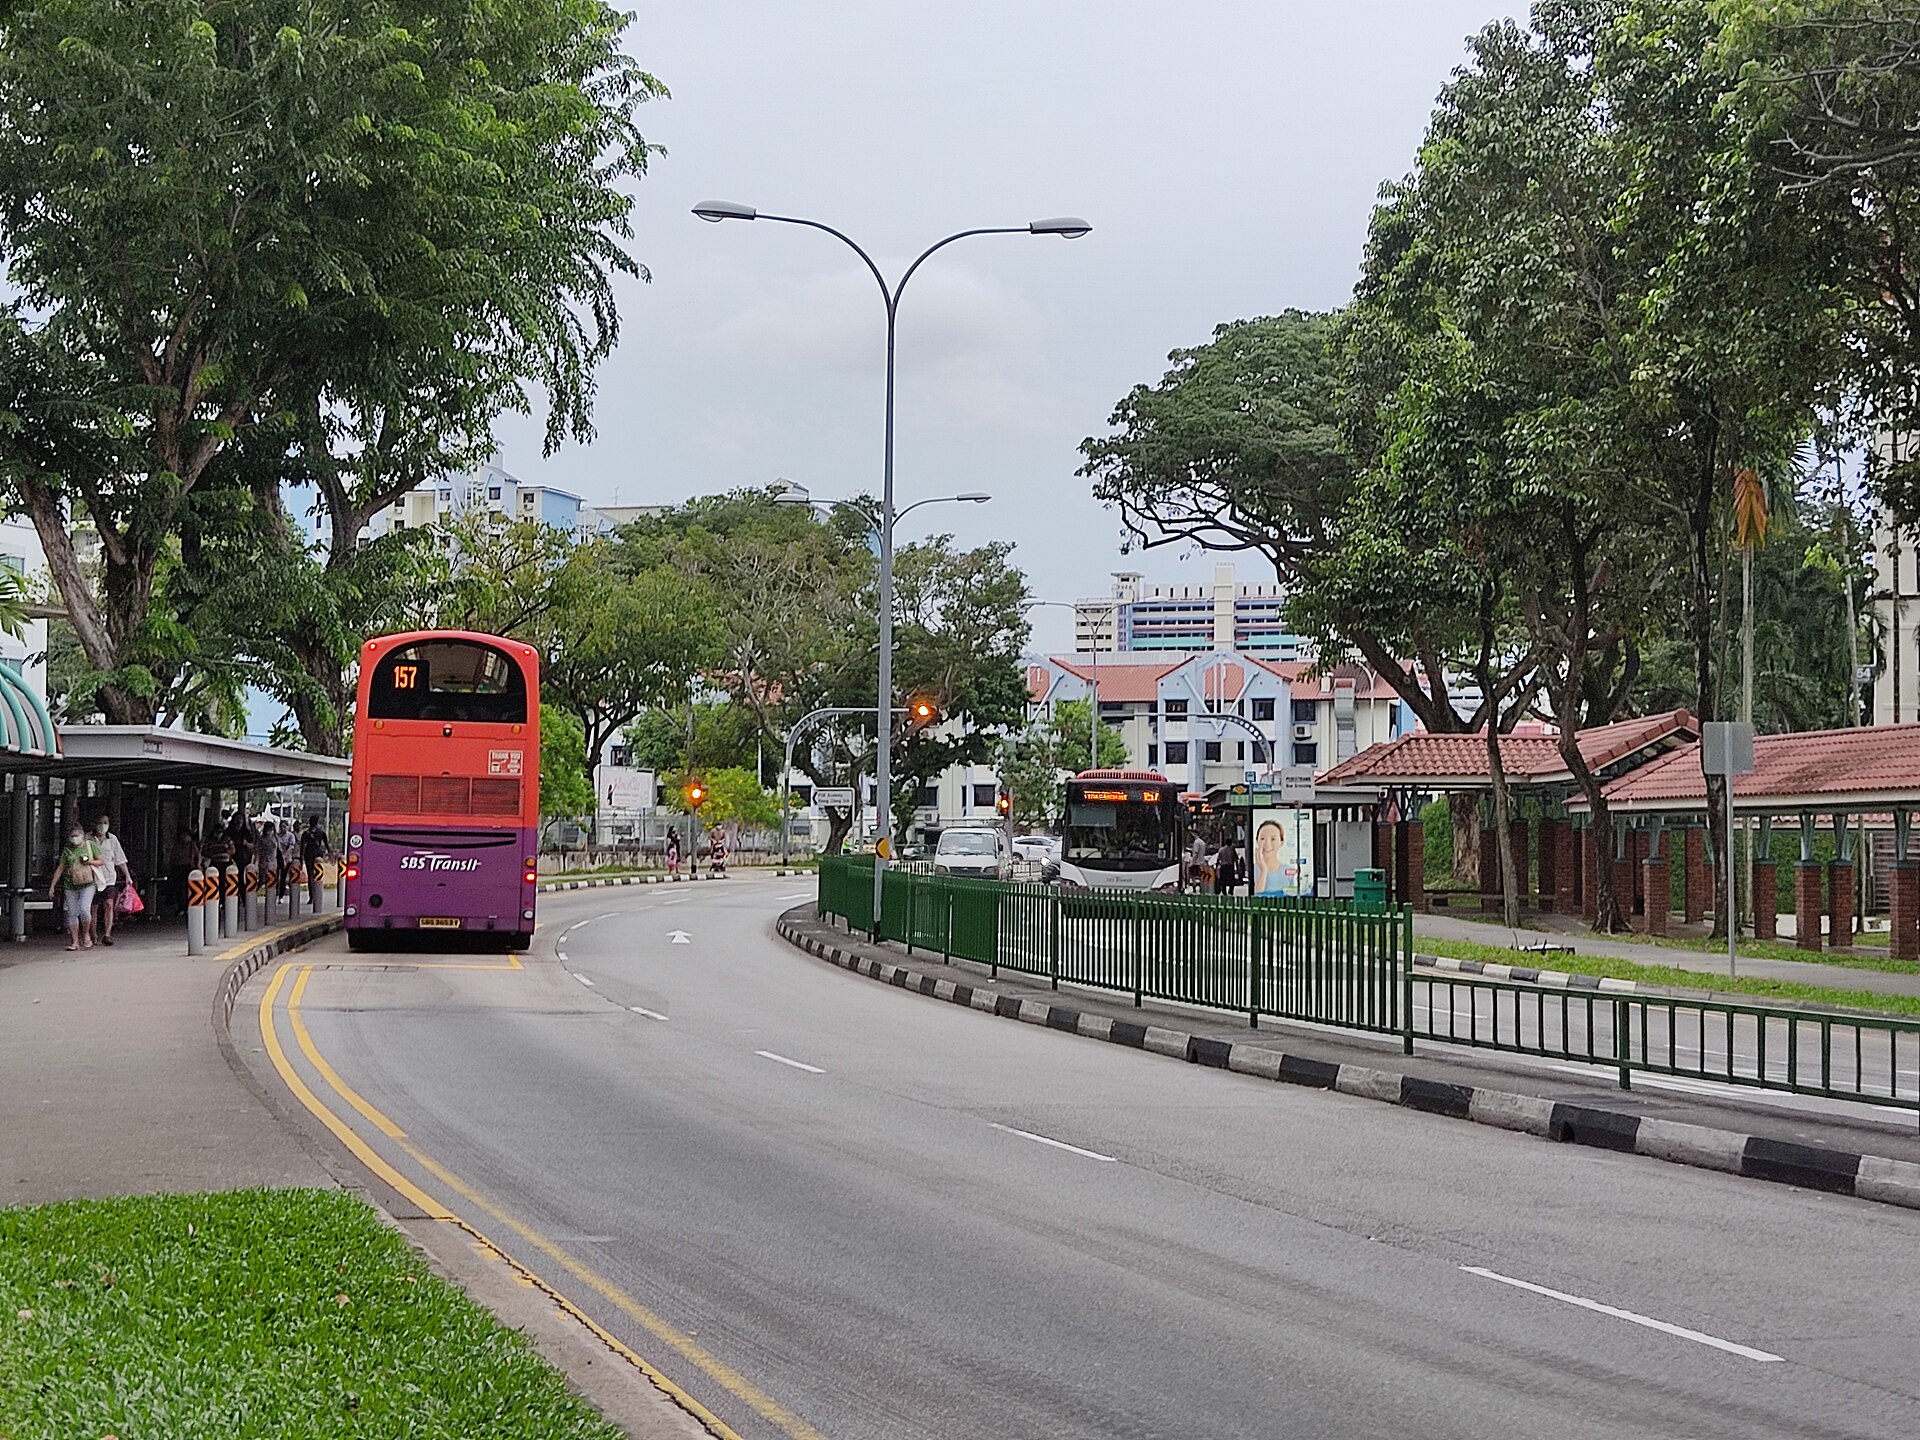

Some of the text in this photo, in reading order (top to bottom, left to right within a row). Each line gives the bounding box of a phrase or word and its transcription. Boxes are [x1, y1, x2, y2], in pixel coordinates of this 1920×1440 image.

[394, 665, 417, 688] 157
[400, 854, 482, 872] SBS Transit
